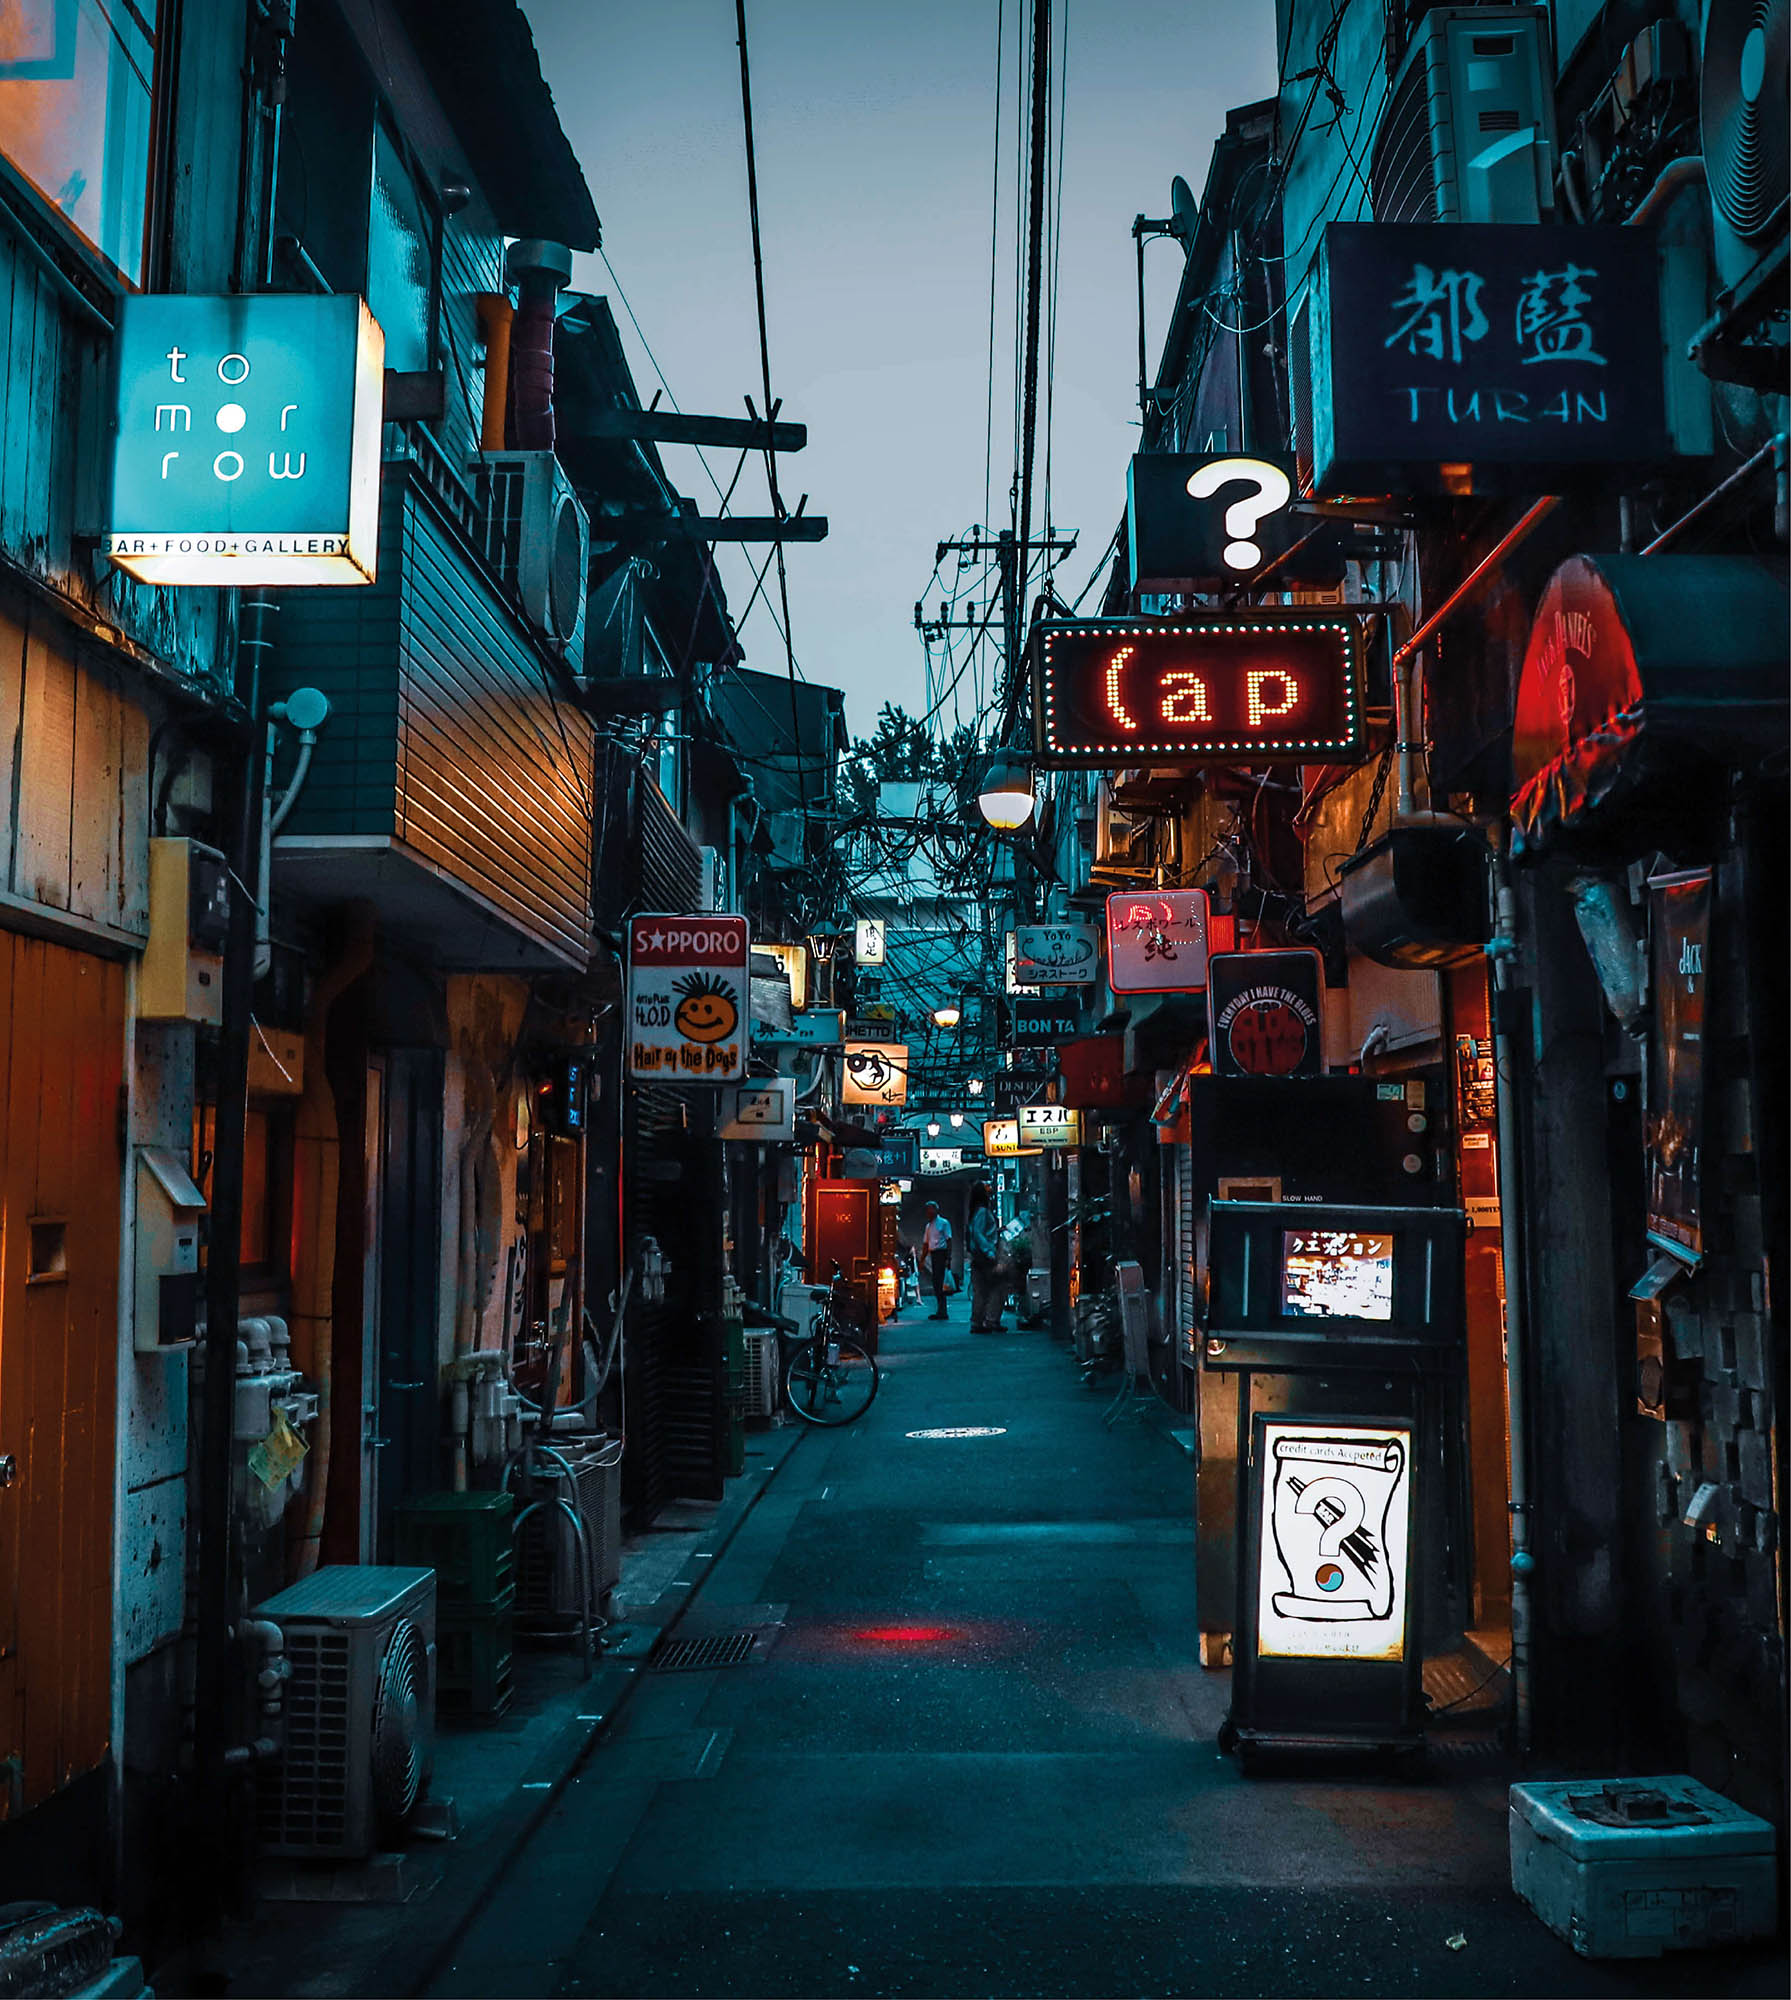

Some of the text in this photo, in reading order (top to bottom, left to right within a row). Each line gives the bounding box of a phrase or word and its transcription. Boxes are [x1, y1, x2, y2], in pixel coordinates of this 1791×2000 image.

[1391, 387, 1608, 424] TURAN
[1217, 991, 1251, 1029] EVERYDAY
[1256, 986, 1280, 998] HAVE
[1280, 988, 1297, 1005] THE
[1294, 999, 1317, 1026] BLUES
[1017, 1019, 1052, 1033] BON
[633, 1043, 738, 1074] Hair of the Dogs
